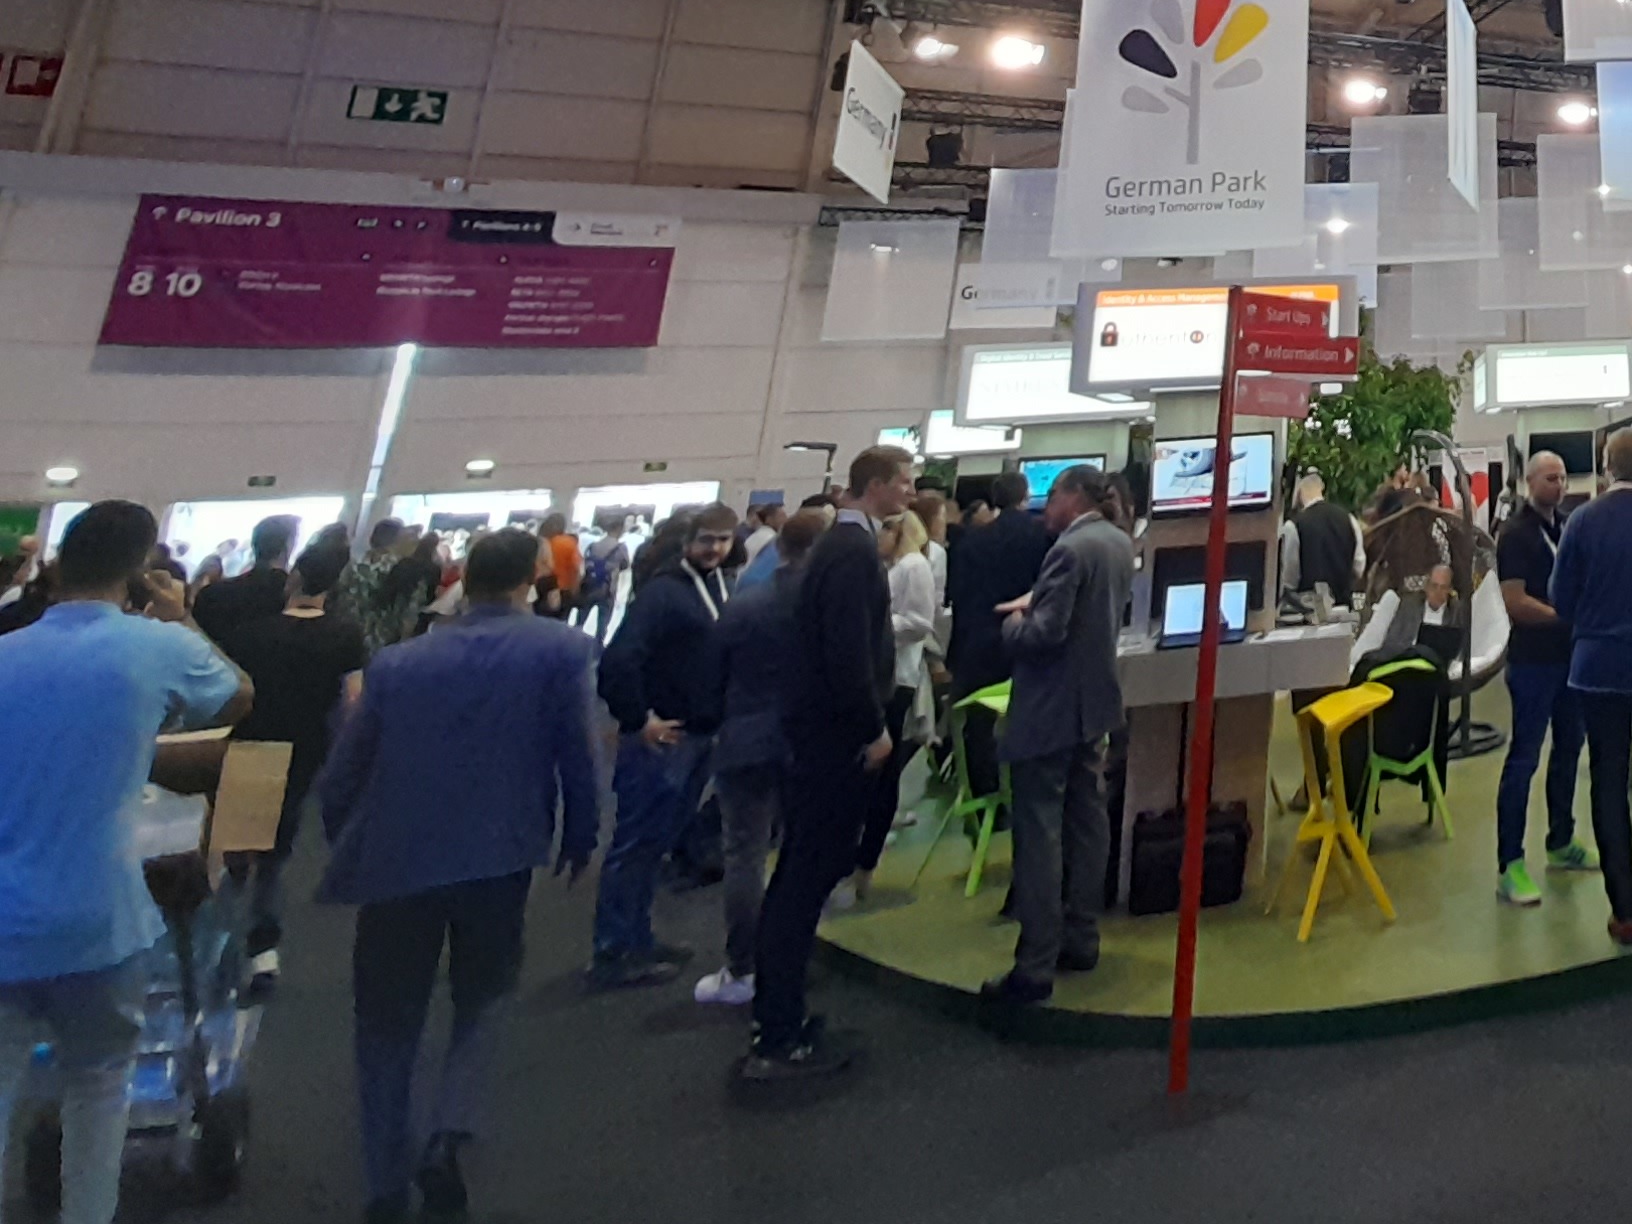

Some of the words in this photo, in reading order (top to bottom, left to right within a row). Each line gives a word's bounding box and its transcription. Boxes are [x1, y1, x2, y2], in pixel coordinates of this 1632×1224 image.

[1105, 176, 1203, 198] German
[1211, 170, 1267, 193] Park
[1105, 202, 1155, 216] Starting
[1159, 200, 1223, 213] Tomorrow
[1228, 197, 1265, 210] Today
[175, 208, 262, 225] Pavilion
[265, 212, 281, 227] 3
[127, 271, 152, 296] 8
[165, 272, 202, 297] 10
[1264, 345, 1339, 362] Information
